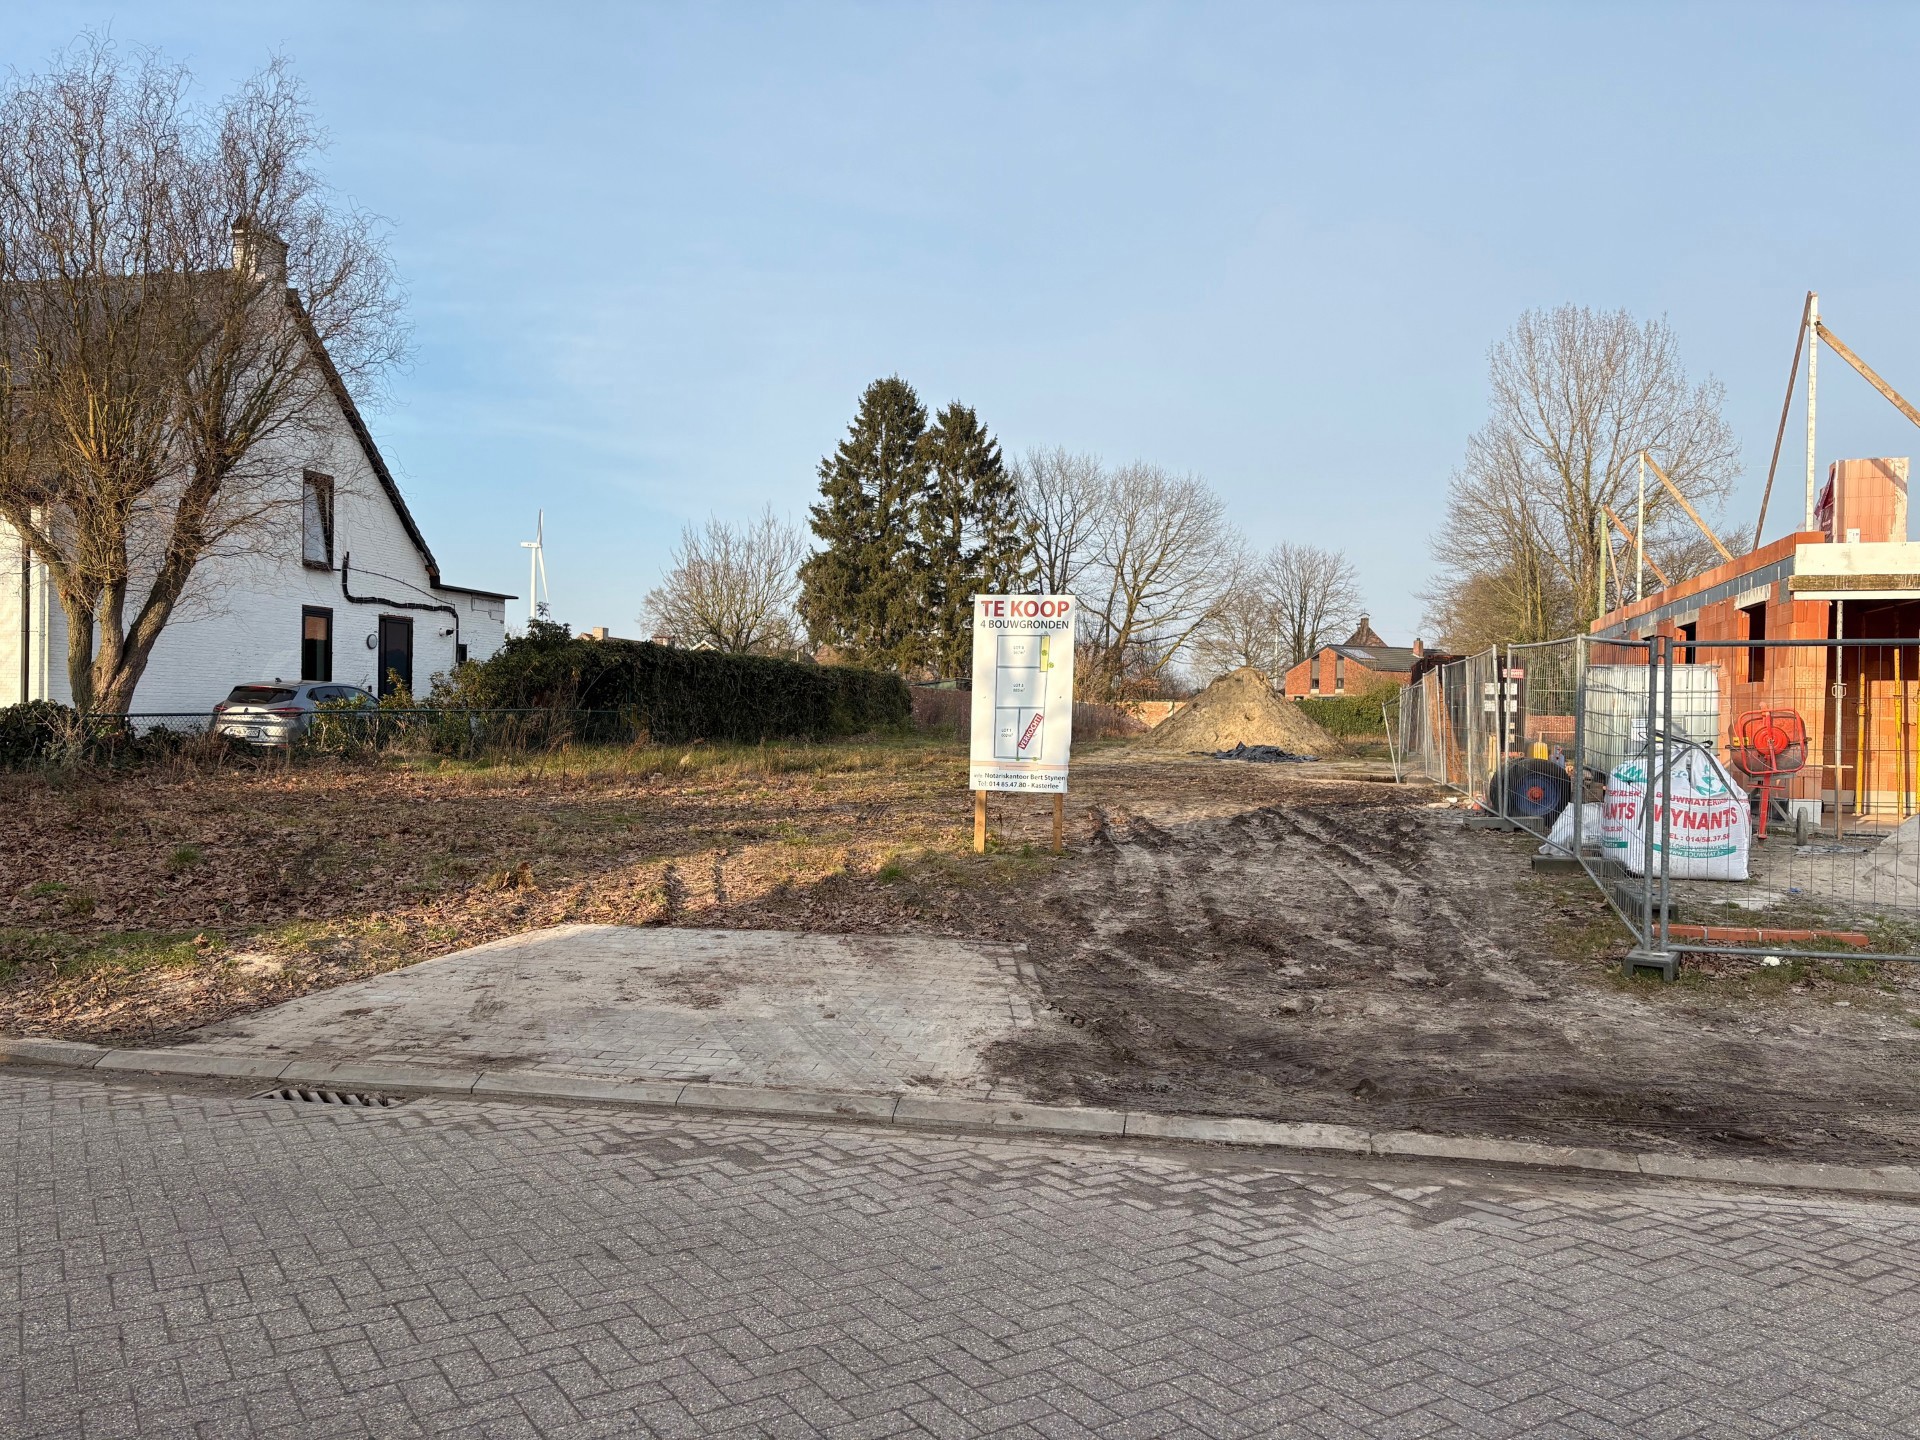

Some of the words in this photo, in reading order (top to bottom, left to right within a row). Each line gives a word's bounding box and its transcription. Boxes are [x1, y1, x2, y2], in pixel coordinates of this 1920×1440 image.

[981, 600, 1005, 617] TE
[1010, 600, 1069, 618] KOOP
[980, 620, 986, 628] 4
[988, 619, 1069, 629] BOUWGRONDEN
[1019, 713, 1043, 749] VERKOCHT!
[985, 772, 1029, 780] Notariskantoor
[1044, 774, 1066, 782] Stynen
[1654, 804, 1738, 830] WYNANTS
